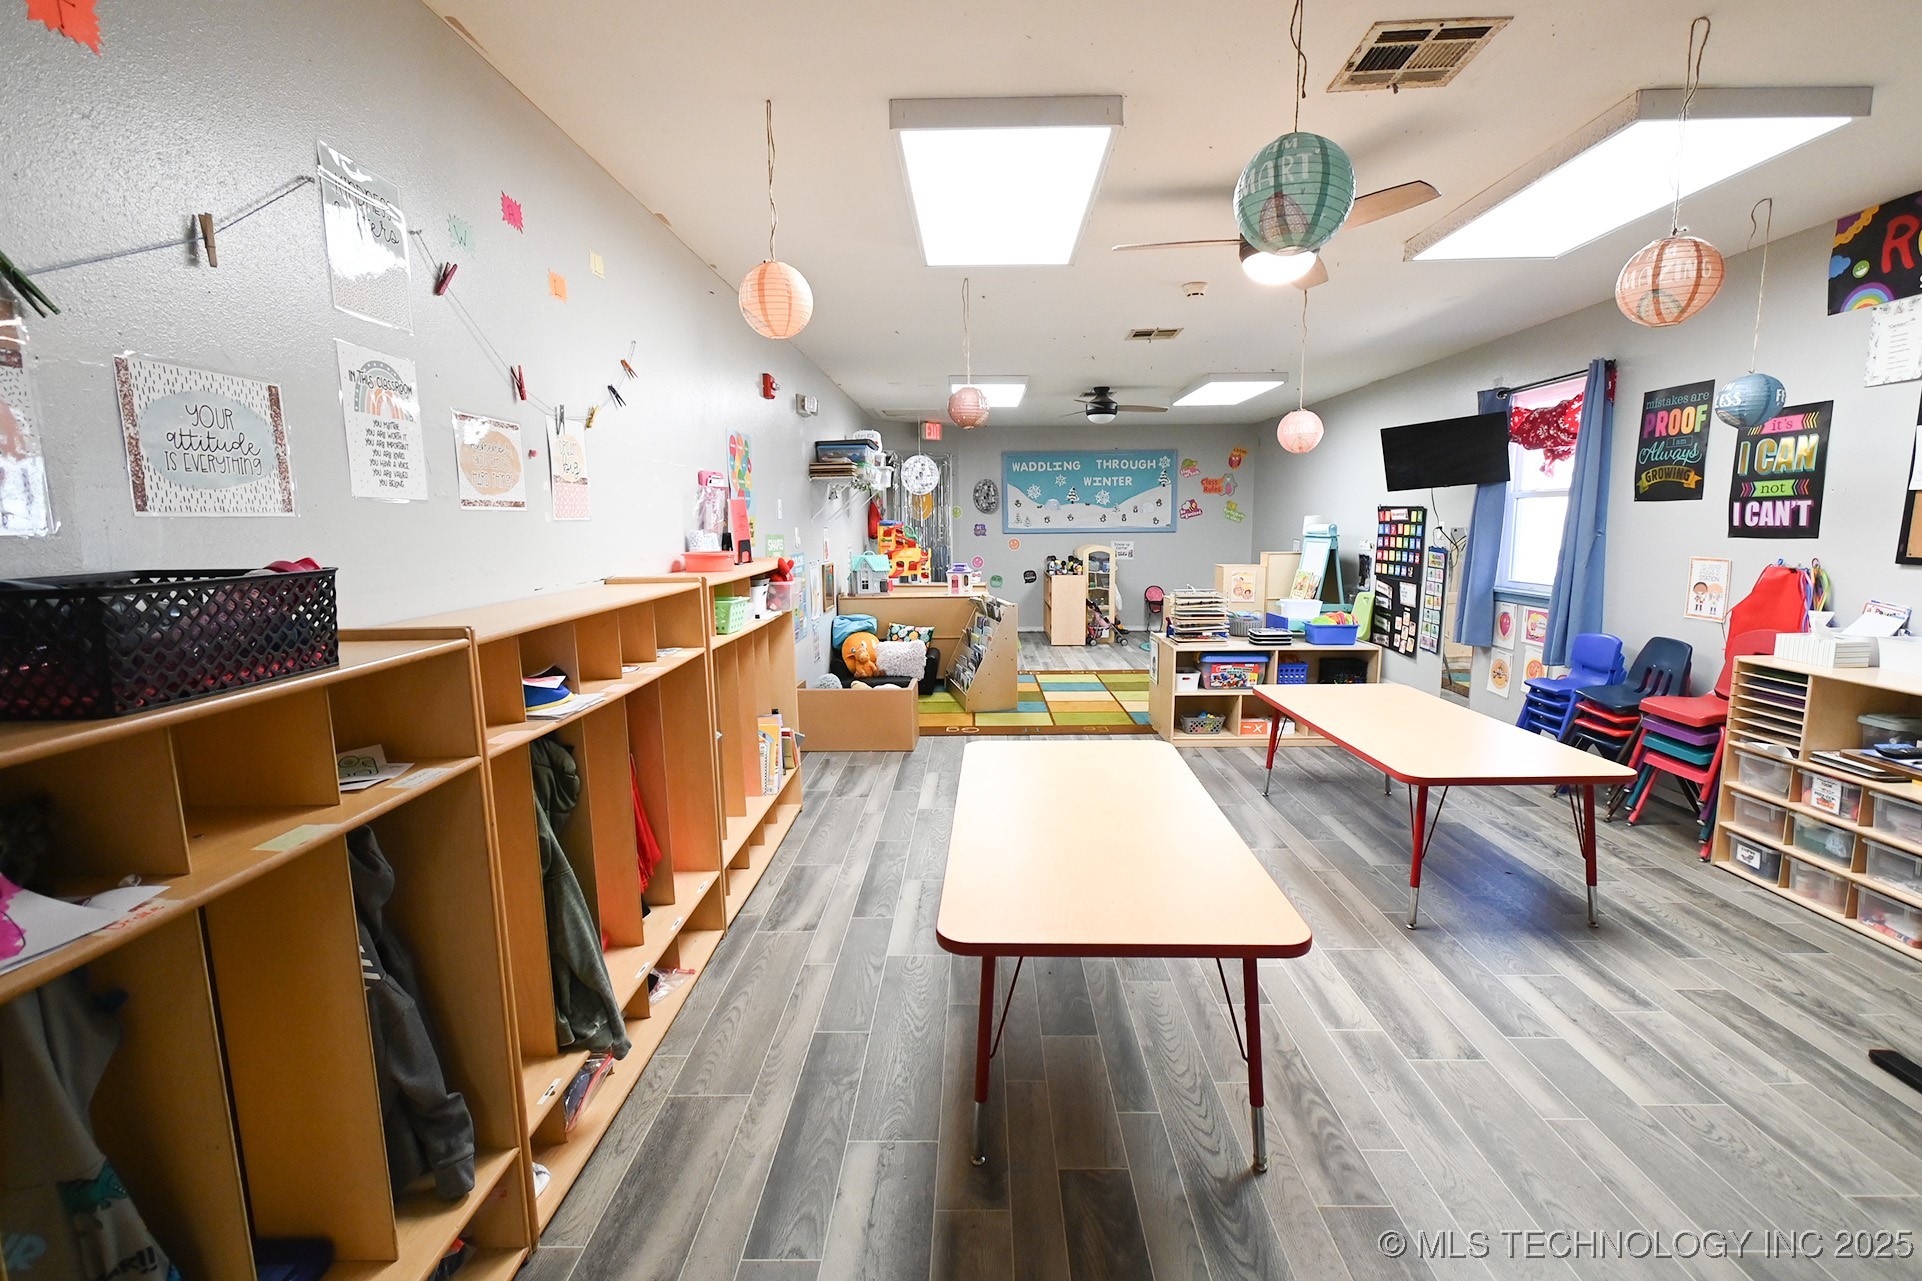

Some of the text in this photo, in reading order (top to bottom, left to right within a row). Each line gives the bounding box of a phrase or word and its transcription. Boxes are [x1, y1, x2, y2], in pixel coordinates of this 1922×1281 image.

[376, 376, 413, 397] CLASSROOM
[1645, 391, 1710, 411] mistakes are
[184, 404, 235, 432] YOUR
[1642, 404, 1709, 439] PROOF
[1771, 419, 1794, 431] it's
[925, 423, 941, 438] EXIT
[166, 427, 262, 457] attitude
[164, 451, 263, 476] IS EVERYTHING
[1638, 441, 1703, 466] Always
[1737, 434, 1820, 477] I CAN
[1011, 459, 1157, 472] WADDLING THROUGH
[1645, 466, 1691, 483] GROWING
[1083, 476, 1133, 487] WINTER
[1760, 484, 1787, 494] not
[1732, 500, 1813, 528] I CAN'T
